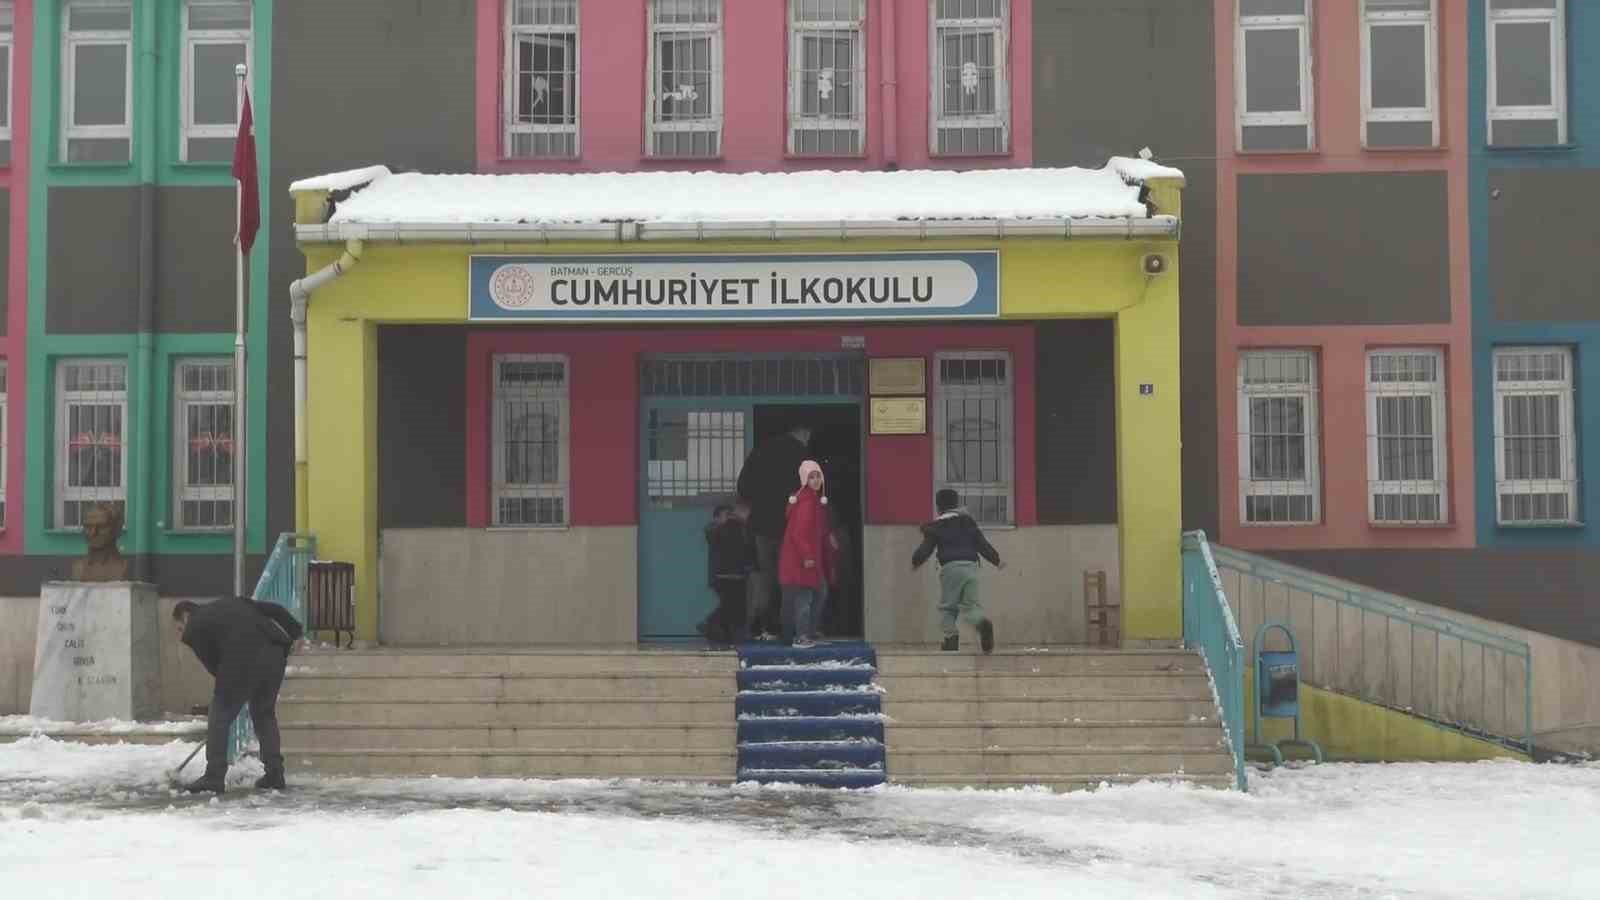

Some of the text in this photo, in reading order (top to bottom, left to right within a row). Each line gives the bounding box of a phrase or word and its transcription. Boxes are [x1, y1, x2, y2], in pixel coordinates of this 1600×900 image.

[550, 266, 589, 276] BATMAN
[551, 271, 933, 305] CUMHURİYET İLKOKULU
